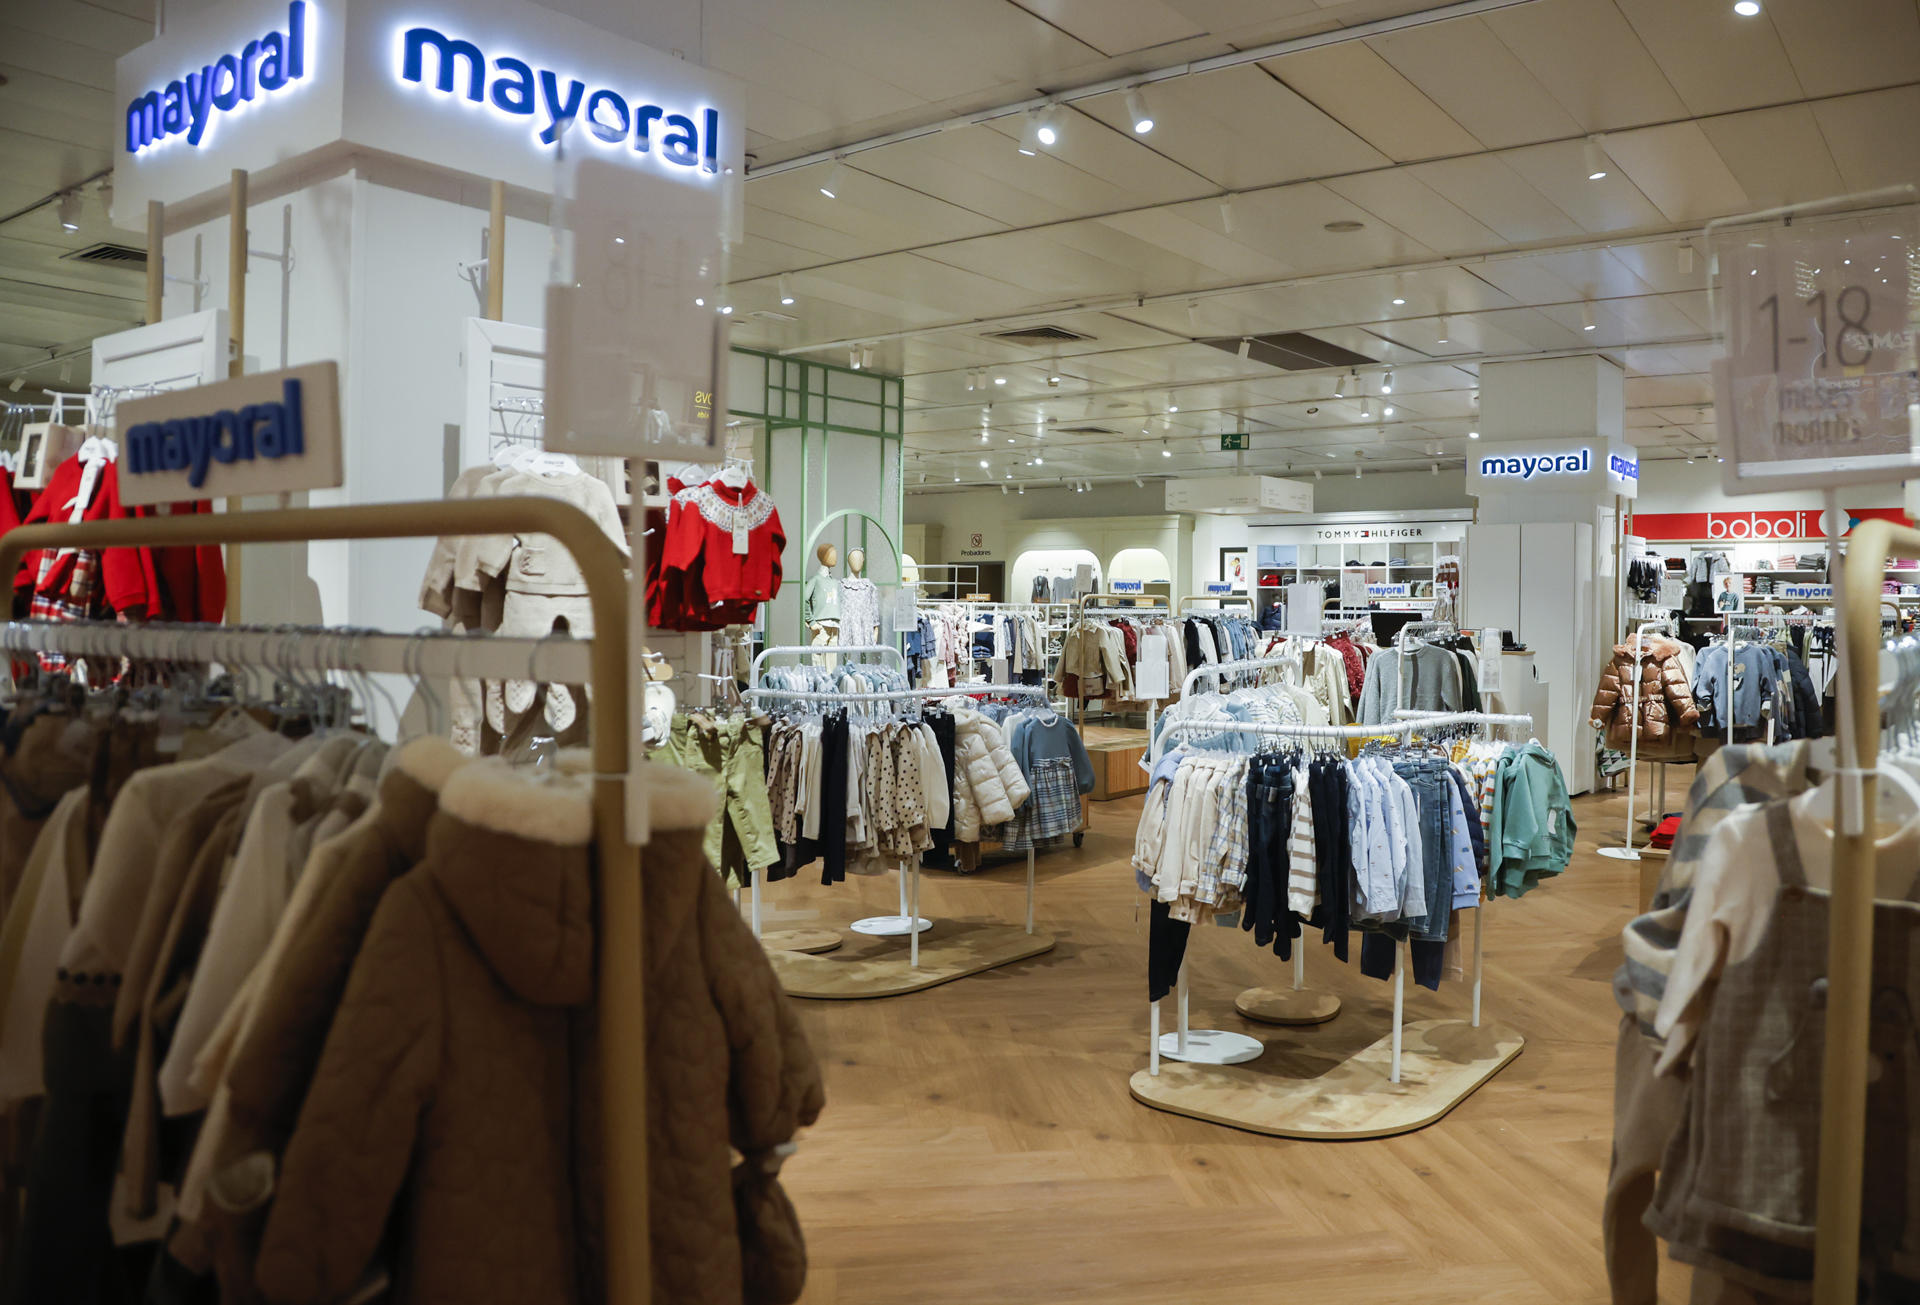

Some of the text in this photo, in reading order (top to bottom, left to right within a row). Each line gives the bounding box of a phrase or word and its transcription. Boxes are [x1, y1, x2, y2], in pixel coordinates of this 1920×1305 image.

[126, 1, 306, 153] mayoral
[402, 26, 719, 174] mayoral
[1759, 285, 1872, 373] 1-18
[126, 378, 305, 488] mayoral
[1481, 449, 1589, 479] mayoral
[1317, 528, 1423, 539] TOMMY HILFIGER
[1707, 511, 1806, 539] boboli
[1114, 580, 1142, 592] mayoral
[1207, 583, 1232, 594] mayoral
[1785, 587, 1833, 598] mayora
